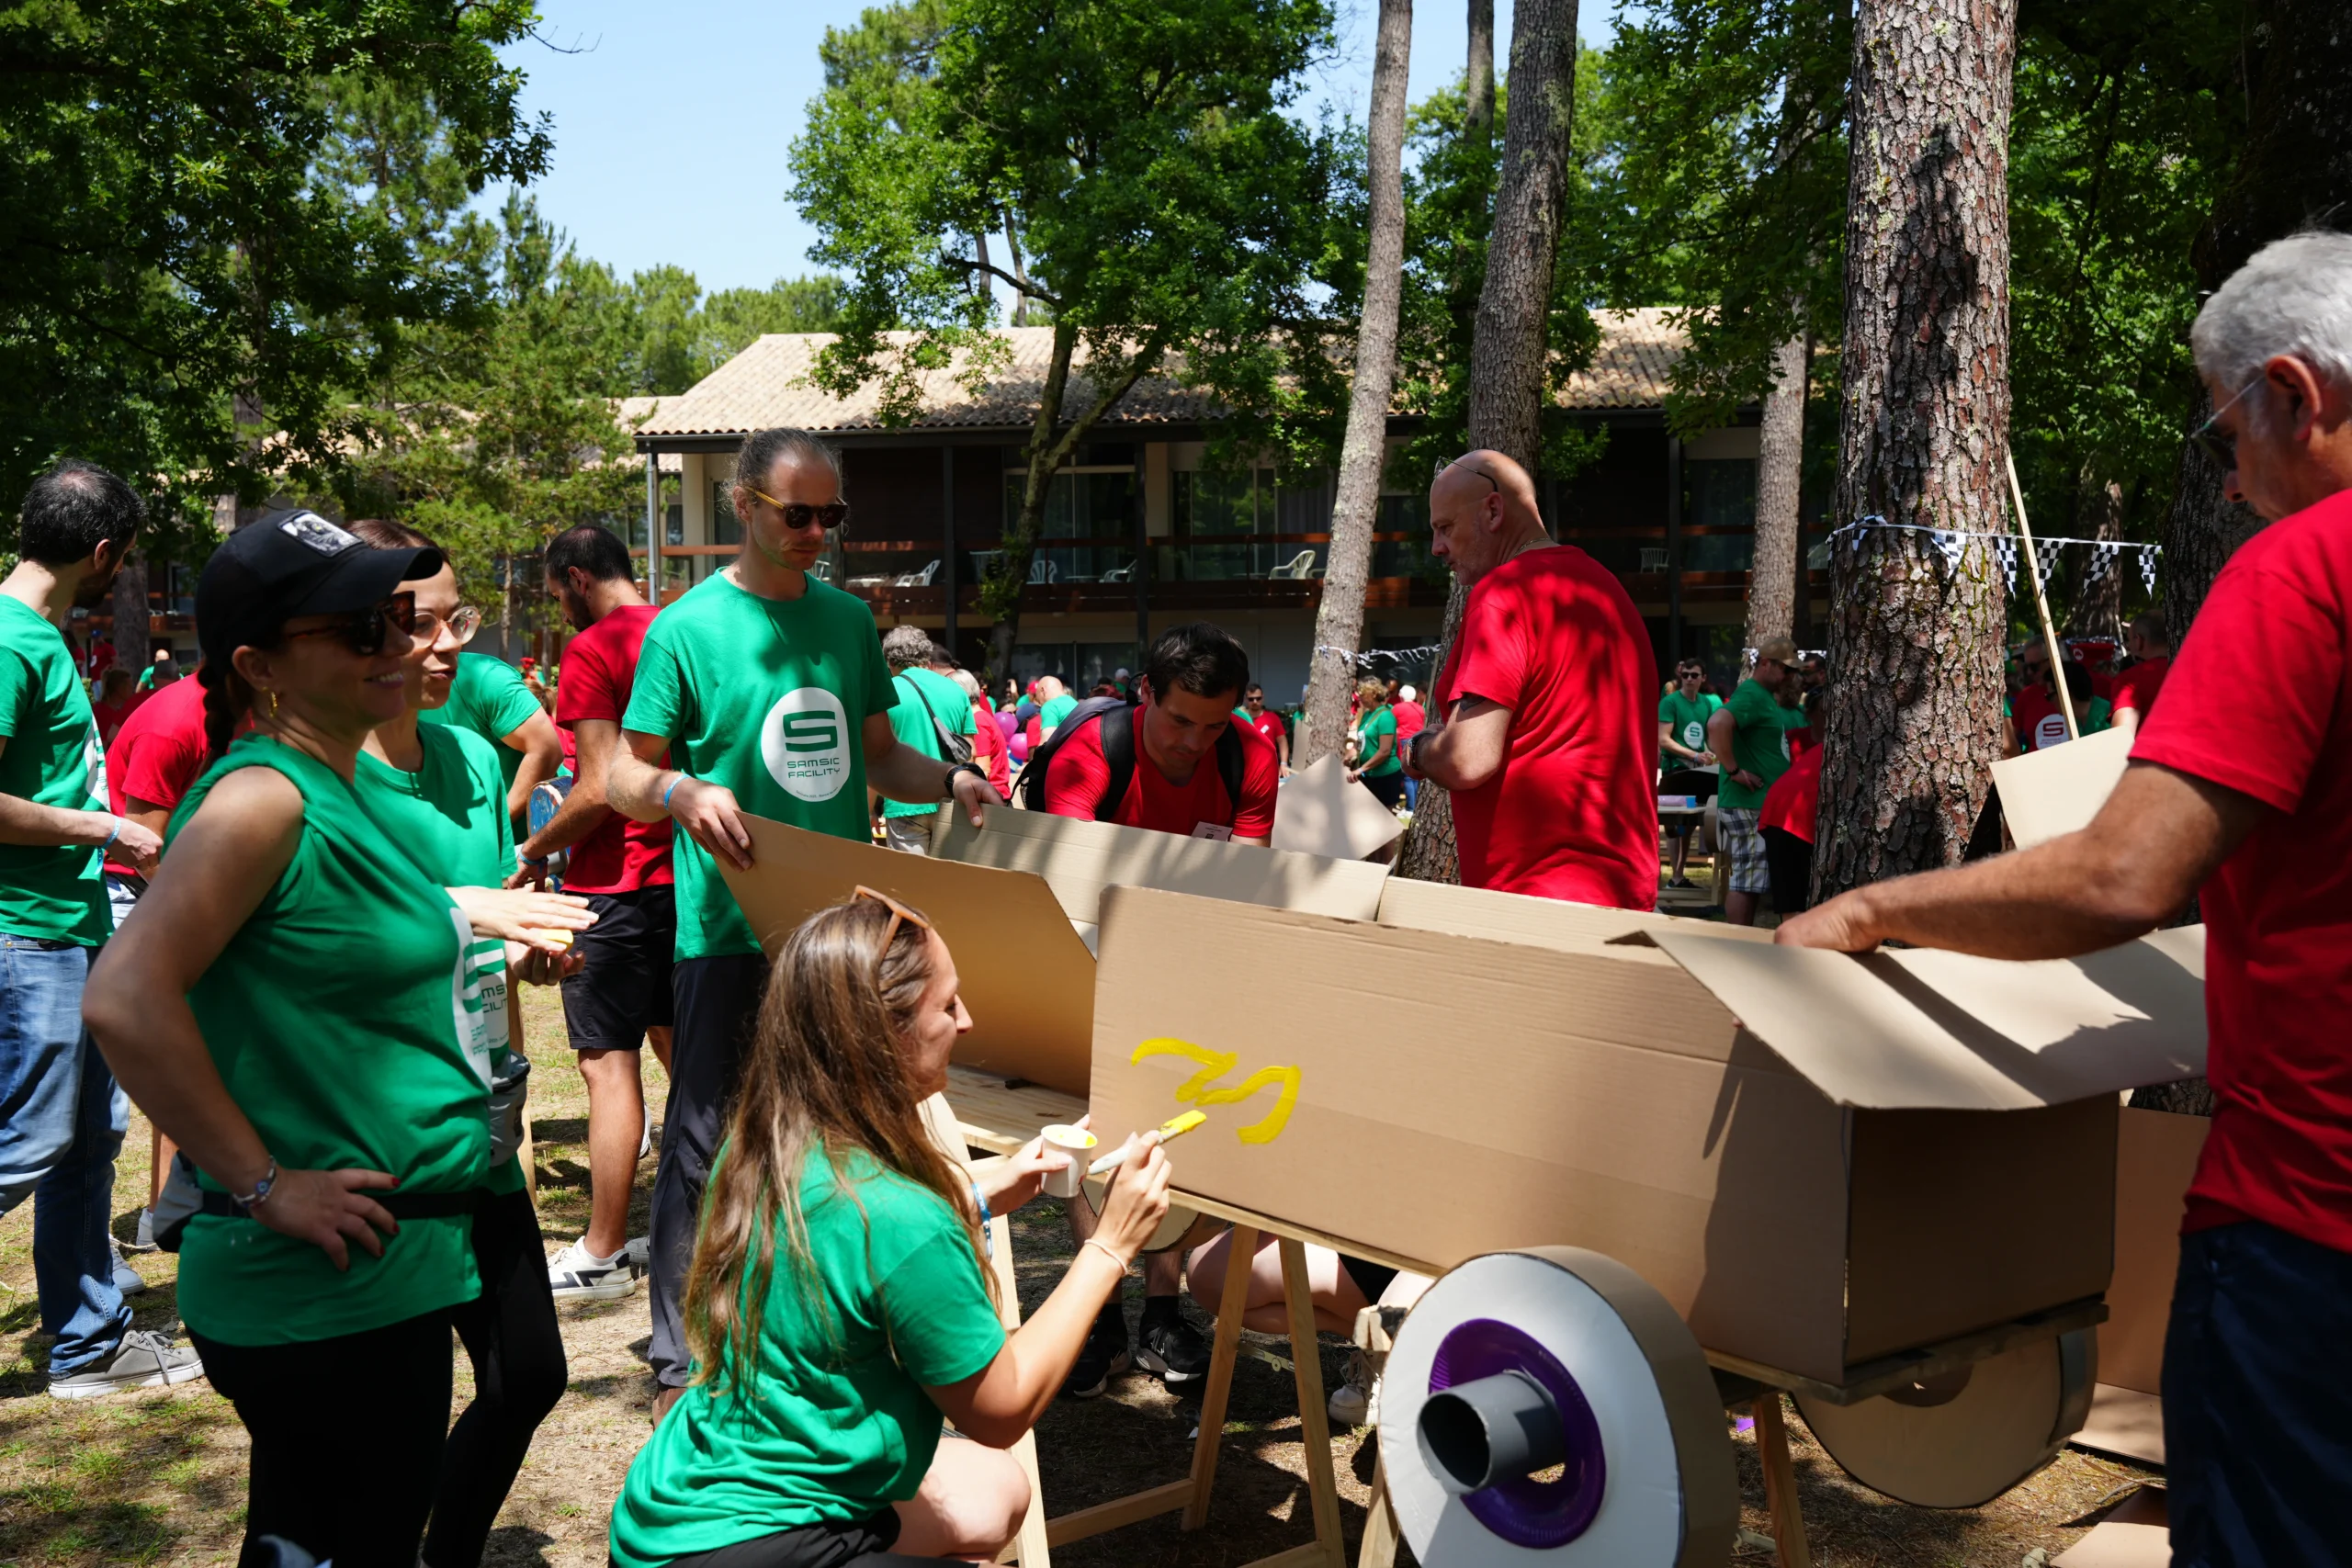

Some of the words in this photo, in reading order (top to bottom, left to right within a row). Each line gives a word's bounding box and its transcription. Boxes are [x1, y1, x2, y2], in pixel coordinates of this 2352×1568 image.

[783, 710, 838, 752] S
[787, 758, 840, 768] SAMSIC
[788, 768, 841, 778] FACILITY
